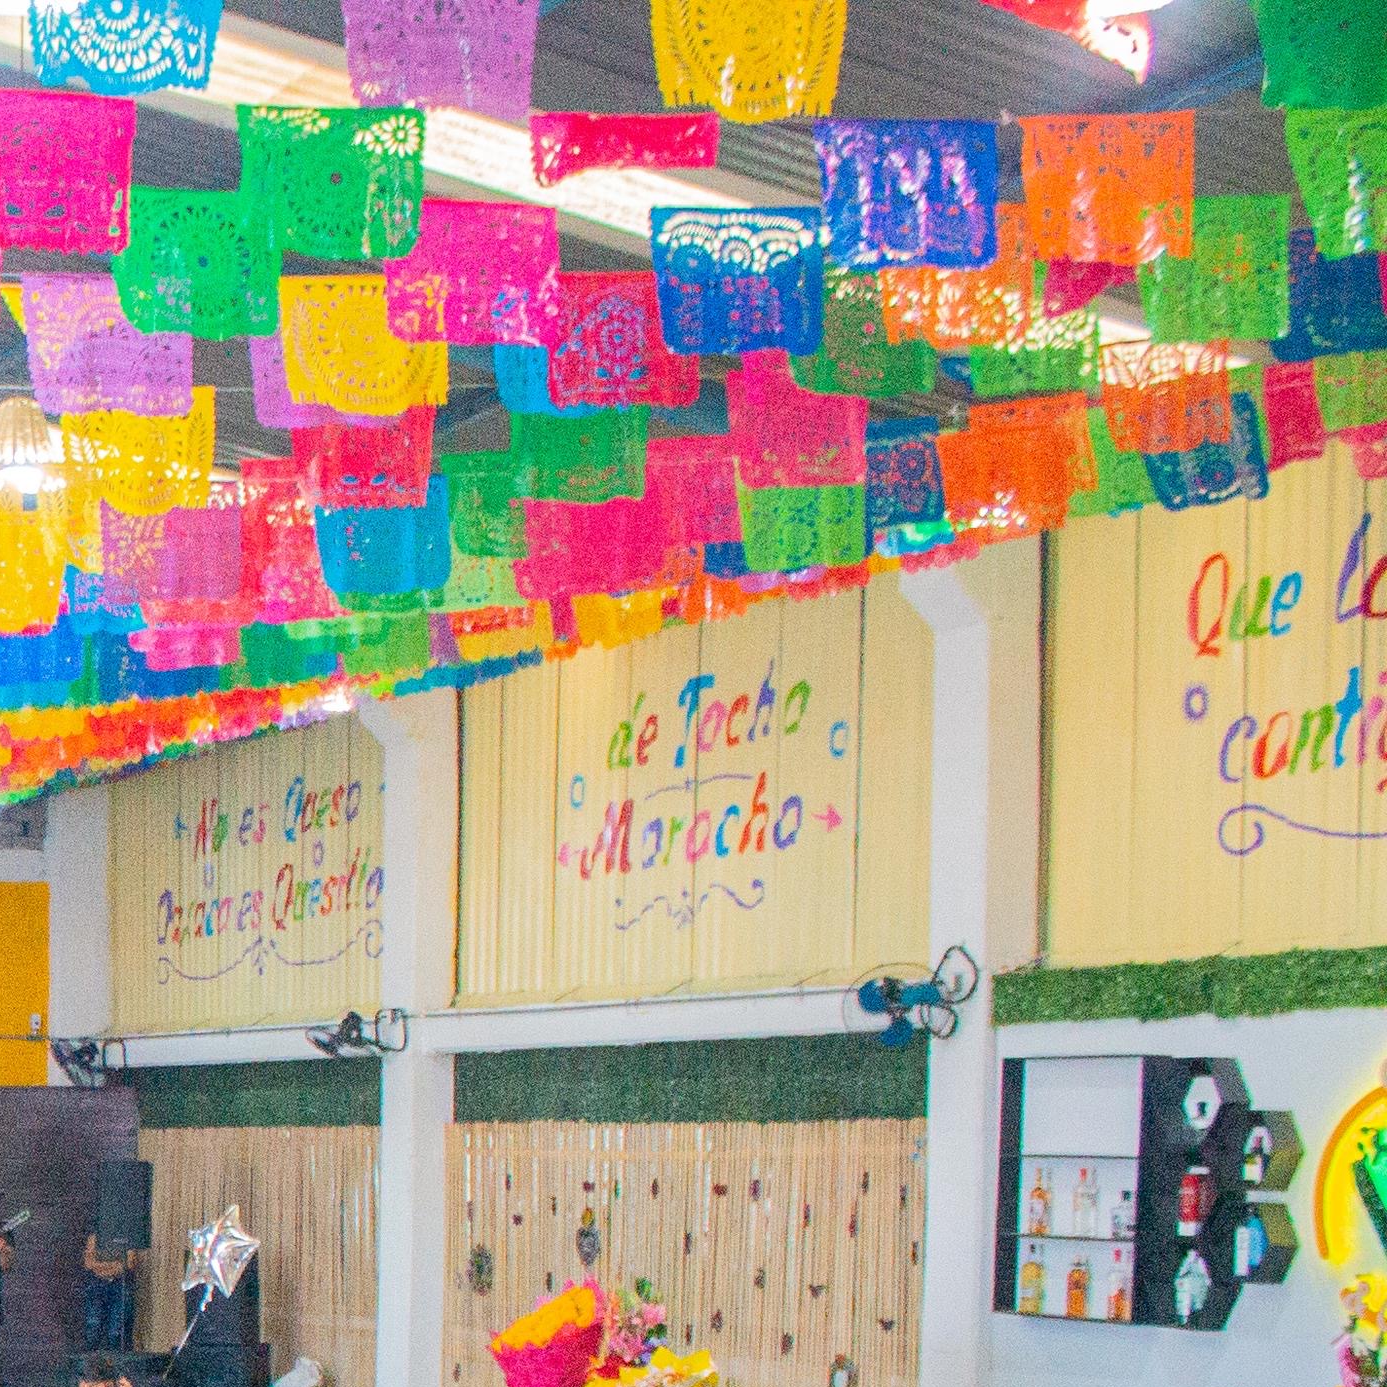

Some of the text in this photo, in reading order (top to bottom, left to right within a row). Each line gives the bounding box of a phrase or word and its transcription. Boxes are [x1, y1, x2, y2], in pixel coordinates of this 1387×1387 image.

[1188, 552, 1303, 657] Que
[607, 656, 812, 771] de Tocho
[193, 799, 228, 862] No
[238, 801, 269, 846] es
